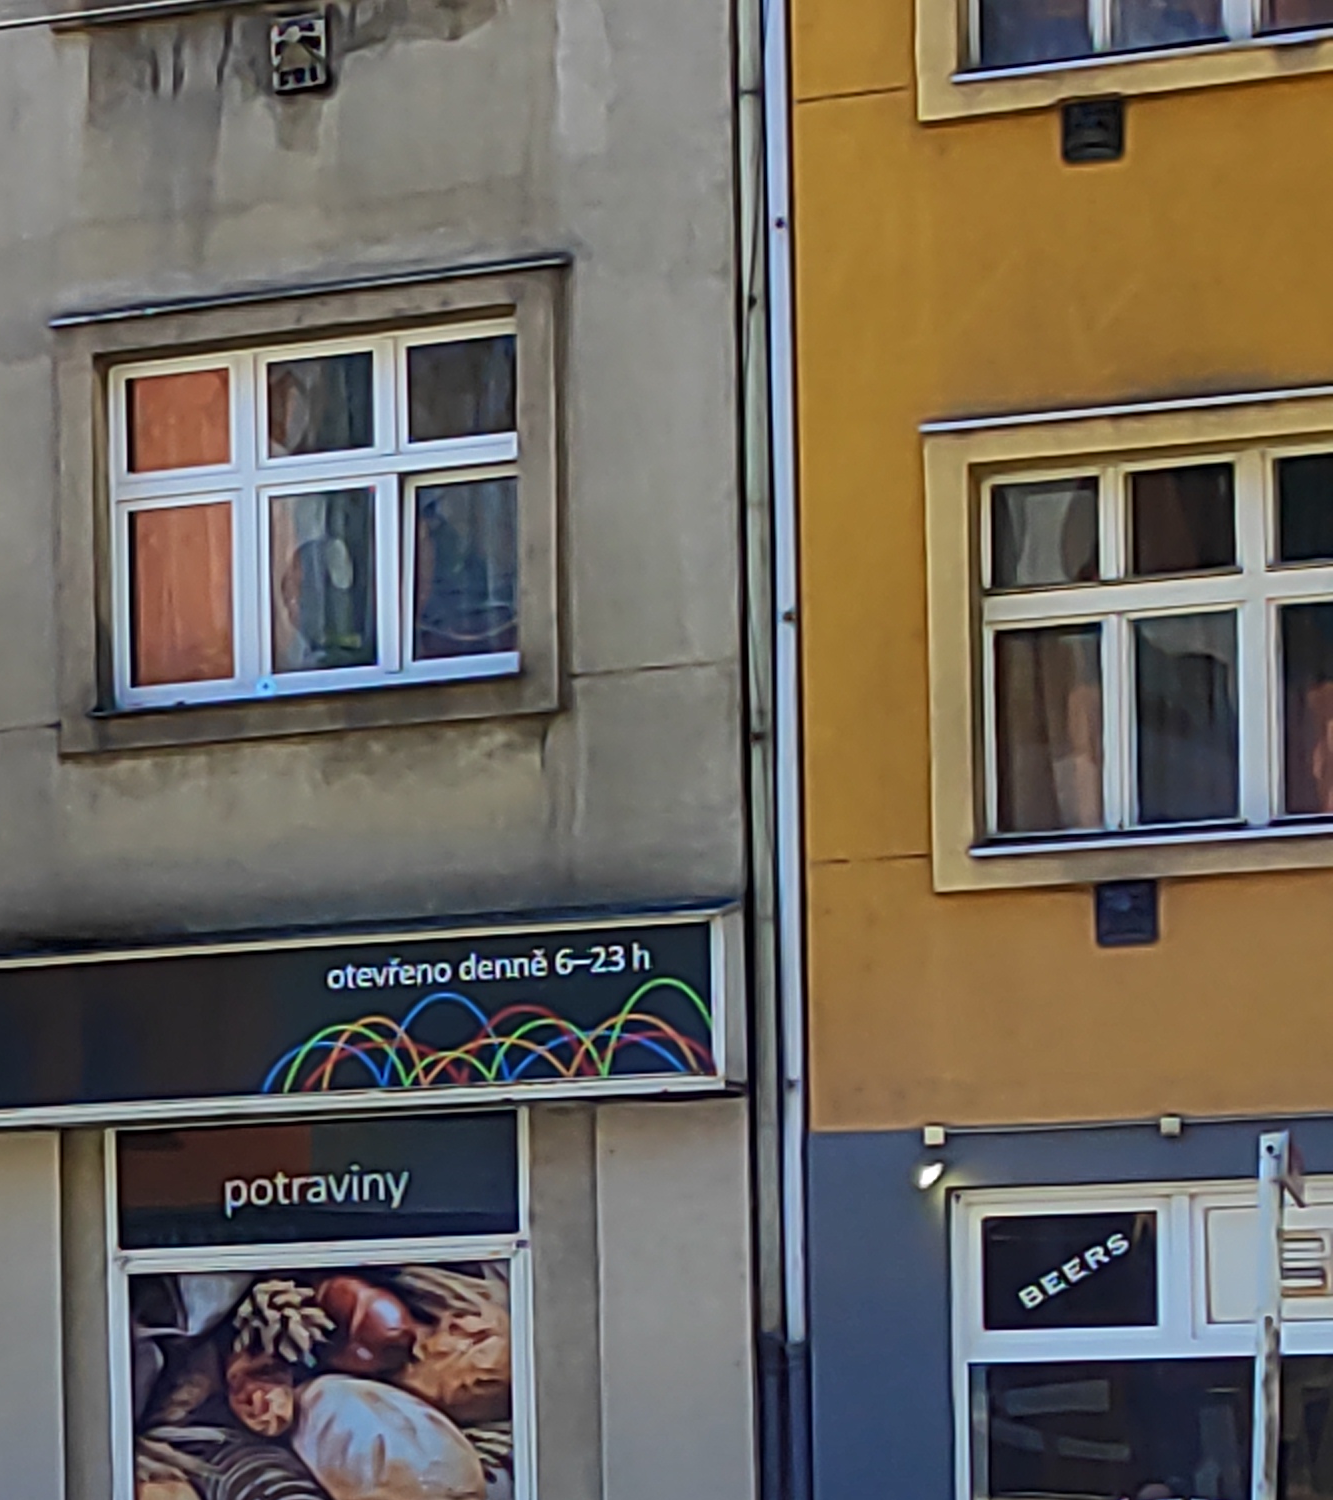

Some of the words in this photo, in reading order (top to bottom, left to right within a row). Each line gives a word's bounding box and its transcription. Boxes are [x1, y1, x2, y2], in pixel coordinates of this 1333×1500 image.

[327, 957, 453, 990] otevřeno
[458, 949, 548, 982] denně
[631, 942, 651, 972] h
[224, 1163, 410, 1219] potraviny
[1018, 1232, 1131, 1310] BEERS
